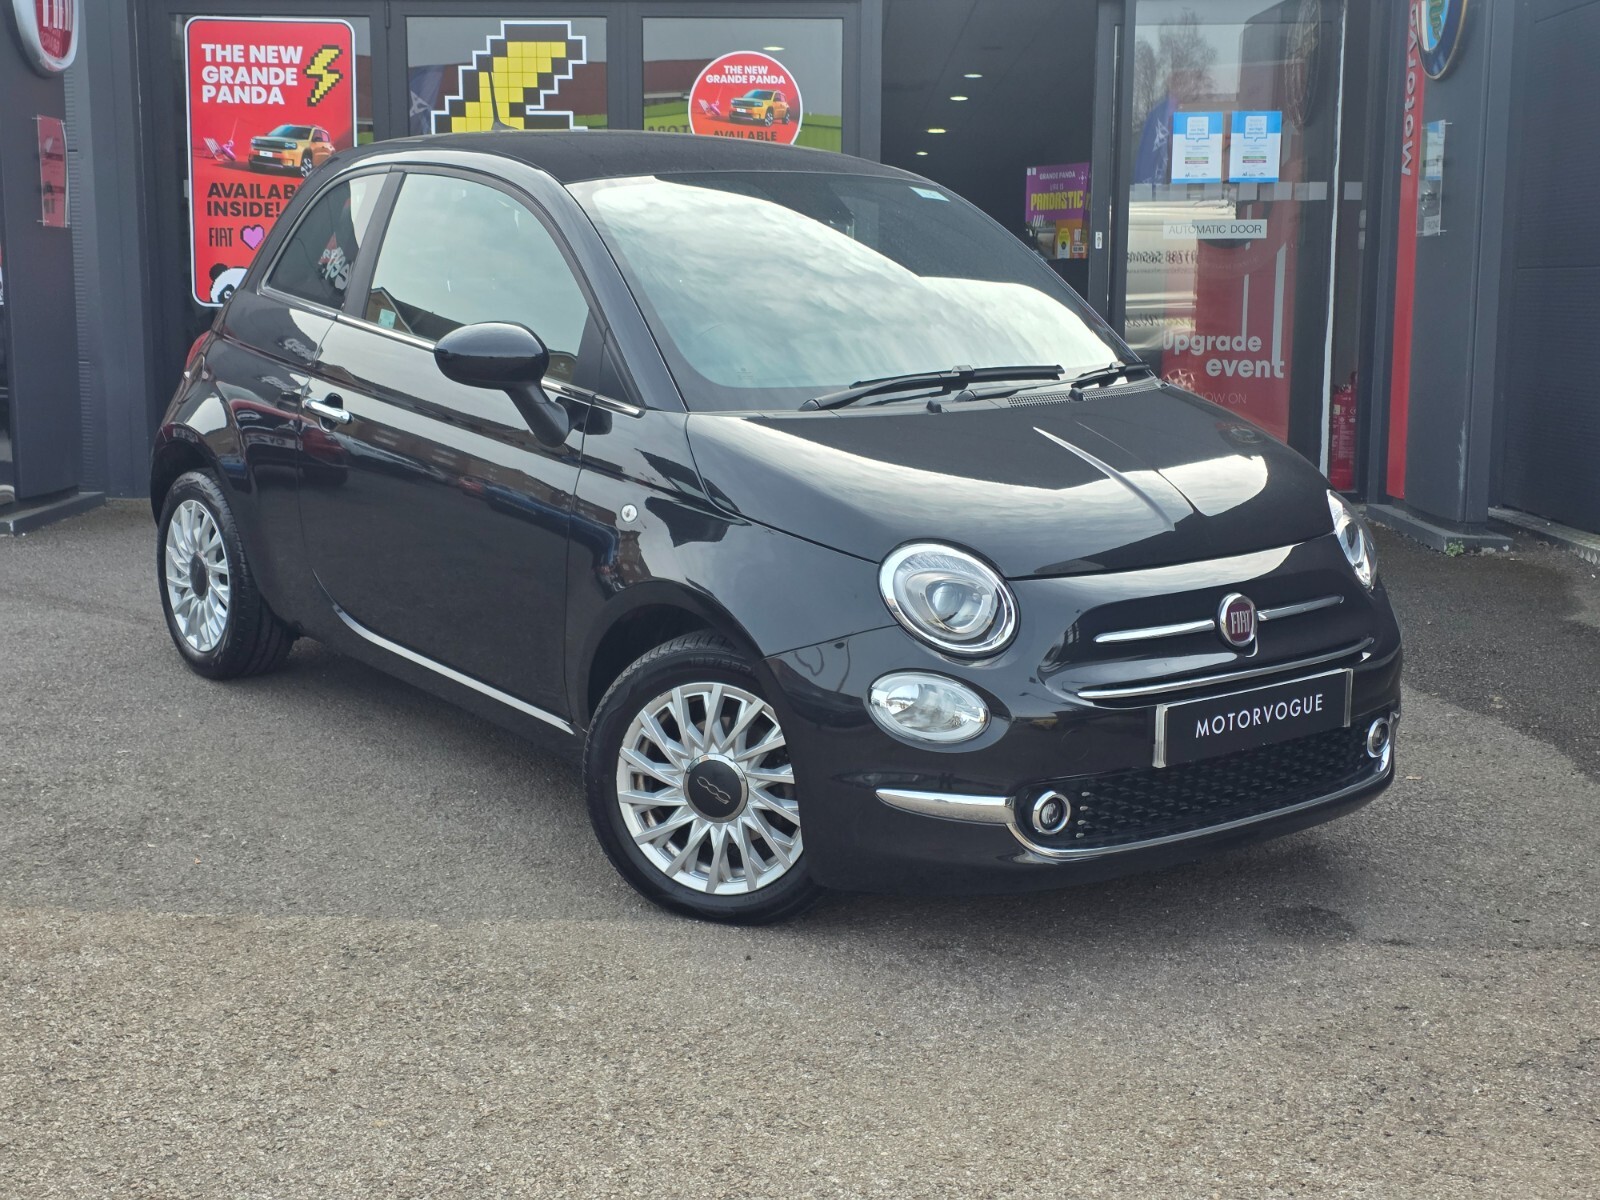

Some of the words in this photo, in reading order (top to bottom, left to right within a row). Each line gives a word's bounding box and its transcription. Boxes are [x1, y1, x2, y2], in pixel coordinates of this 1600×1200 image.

[201, 43, 245, 63] THE
[249, 45, 303, 64] NEW
[202, 65, 298, 86] GRANDE
[705, 74, 748, 84] GRANDE
[750, 75, 786, 84] PANDA
[723, 65, 742, 74] THE
[745, 65, 768, 75] NEW
[202, 84, 285, 105] PANDA
[1040, 172, 1059, 180] GRANDE
[1059, 170, 1076, 179] PANDA
[207, 182, 297, 199] AVAILAB
[1030, 190, 1084, 211] PANDASTIC
[207, 201, 281, 218] INSIDE!
[208, 227, 234, 247] FIAT
[1168, 224, 1227, 234] AUTOMATIC
[1230, 224, 1262, 234] DOOR
[1162, 330, 1262, 356] Upgrade
[1205, 357, 1285, 379] event
[1228, 392, 1247, 404] ON
[1230, 610, 1250, 634] FIAT
[1195, 693, 1323, 739] MOTORVOGUE
